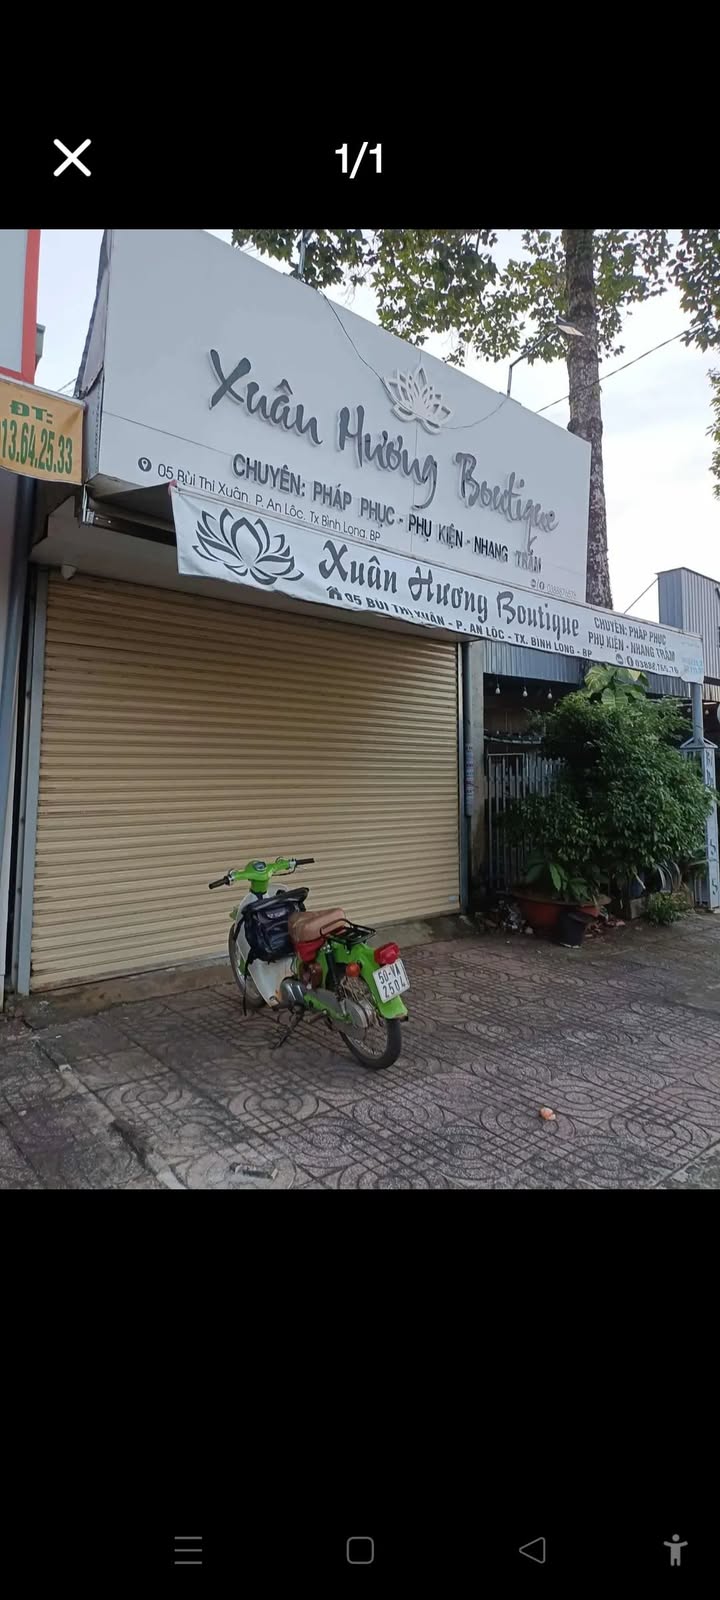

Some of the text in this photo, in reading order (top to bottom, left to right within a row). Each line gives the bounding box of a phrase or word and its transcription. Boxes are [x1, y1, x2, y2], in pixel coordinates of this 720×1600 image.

[9, 399, 54, 425] ĐT:
[209, 348, 559, 551] Xuân Hương Boutique
[157, 462, 174, 481] 05
[267, 498, 282, 514] An
[310, 510, 320, 525] Tx
[321, 514, 341, 532] Bình
[369, 528, 382, 543] BP
[232, 453, 306, 498] CHUYÊN:
[312, 480, 353, 512] PHÁP
[360, 496, 397, 530] PHỤC
[408, 512, 433, 543] PHỤ
[437, 522, 464, 550] KIỆN
[474, 534, 509, 564] NHANG
[318, 539, 580, 641] Xuân Hương Boutique
[344, 592, 362, 606] 05
[365, 596, 389, 612] BÙI
[469, 623, 483, 636] AN
[514, 632, 529, 645] TX.
[530, 635, 552, 650] BÌNH
[554, 641, 575, 655] LONG
[582, 648, 593, 658] BP
[588, 630, 605, 650] PHỤ
[606, 633, 624, 653] KIỆN
[630, 641, 655, 658] NHANG
[593, 616, 628, 637] CHUYÊN:
[649, 631, 667, 648] PHỤC
[382, 975, 406, 999] 2504
